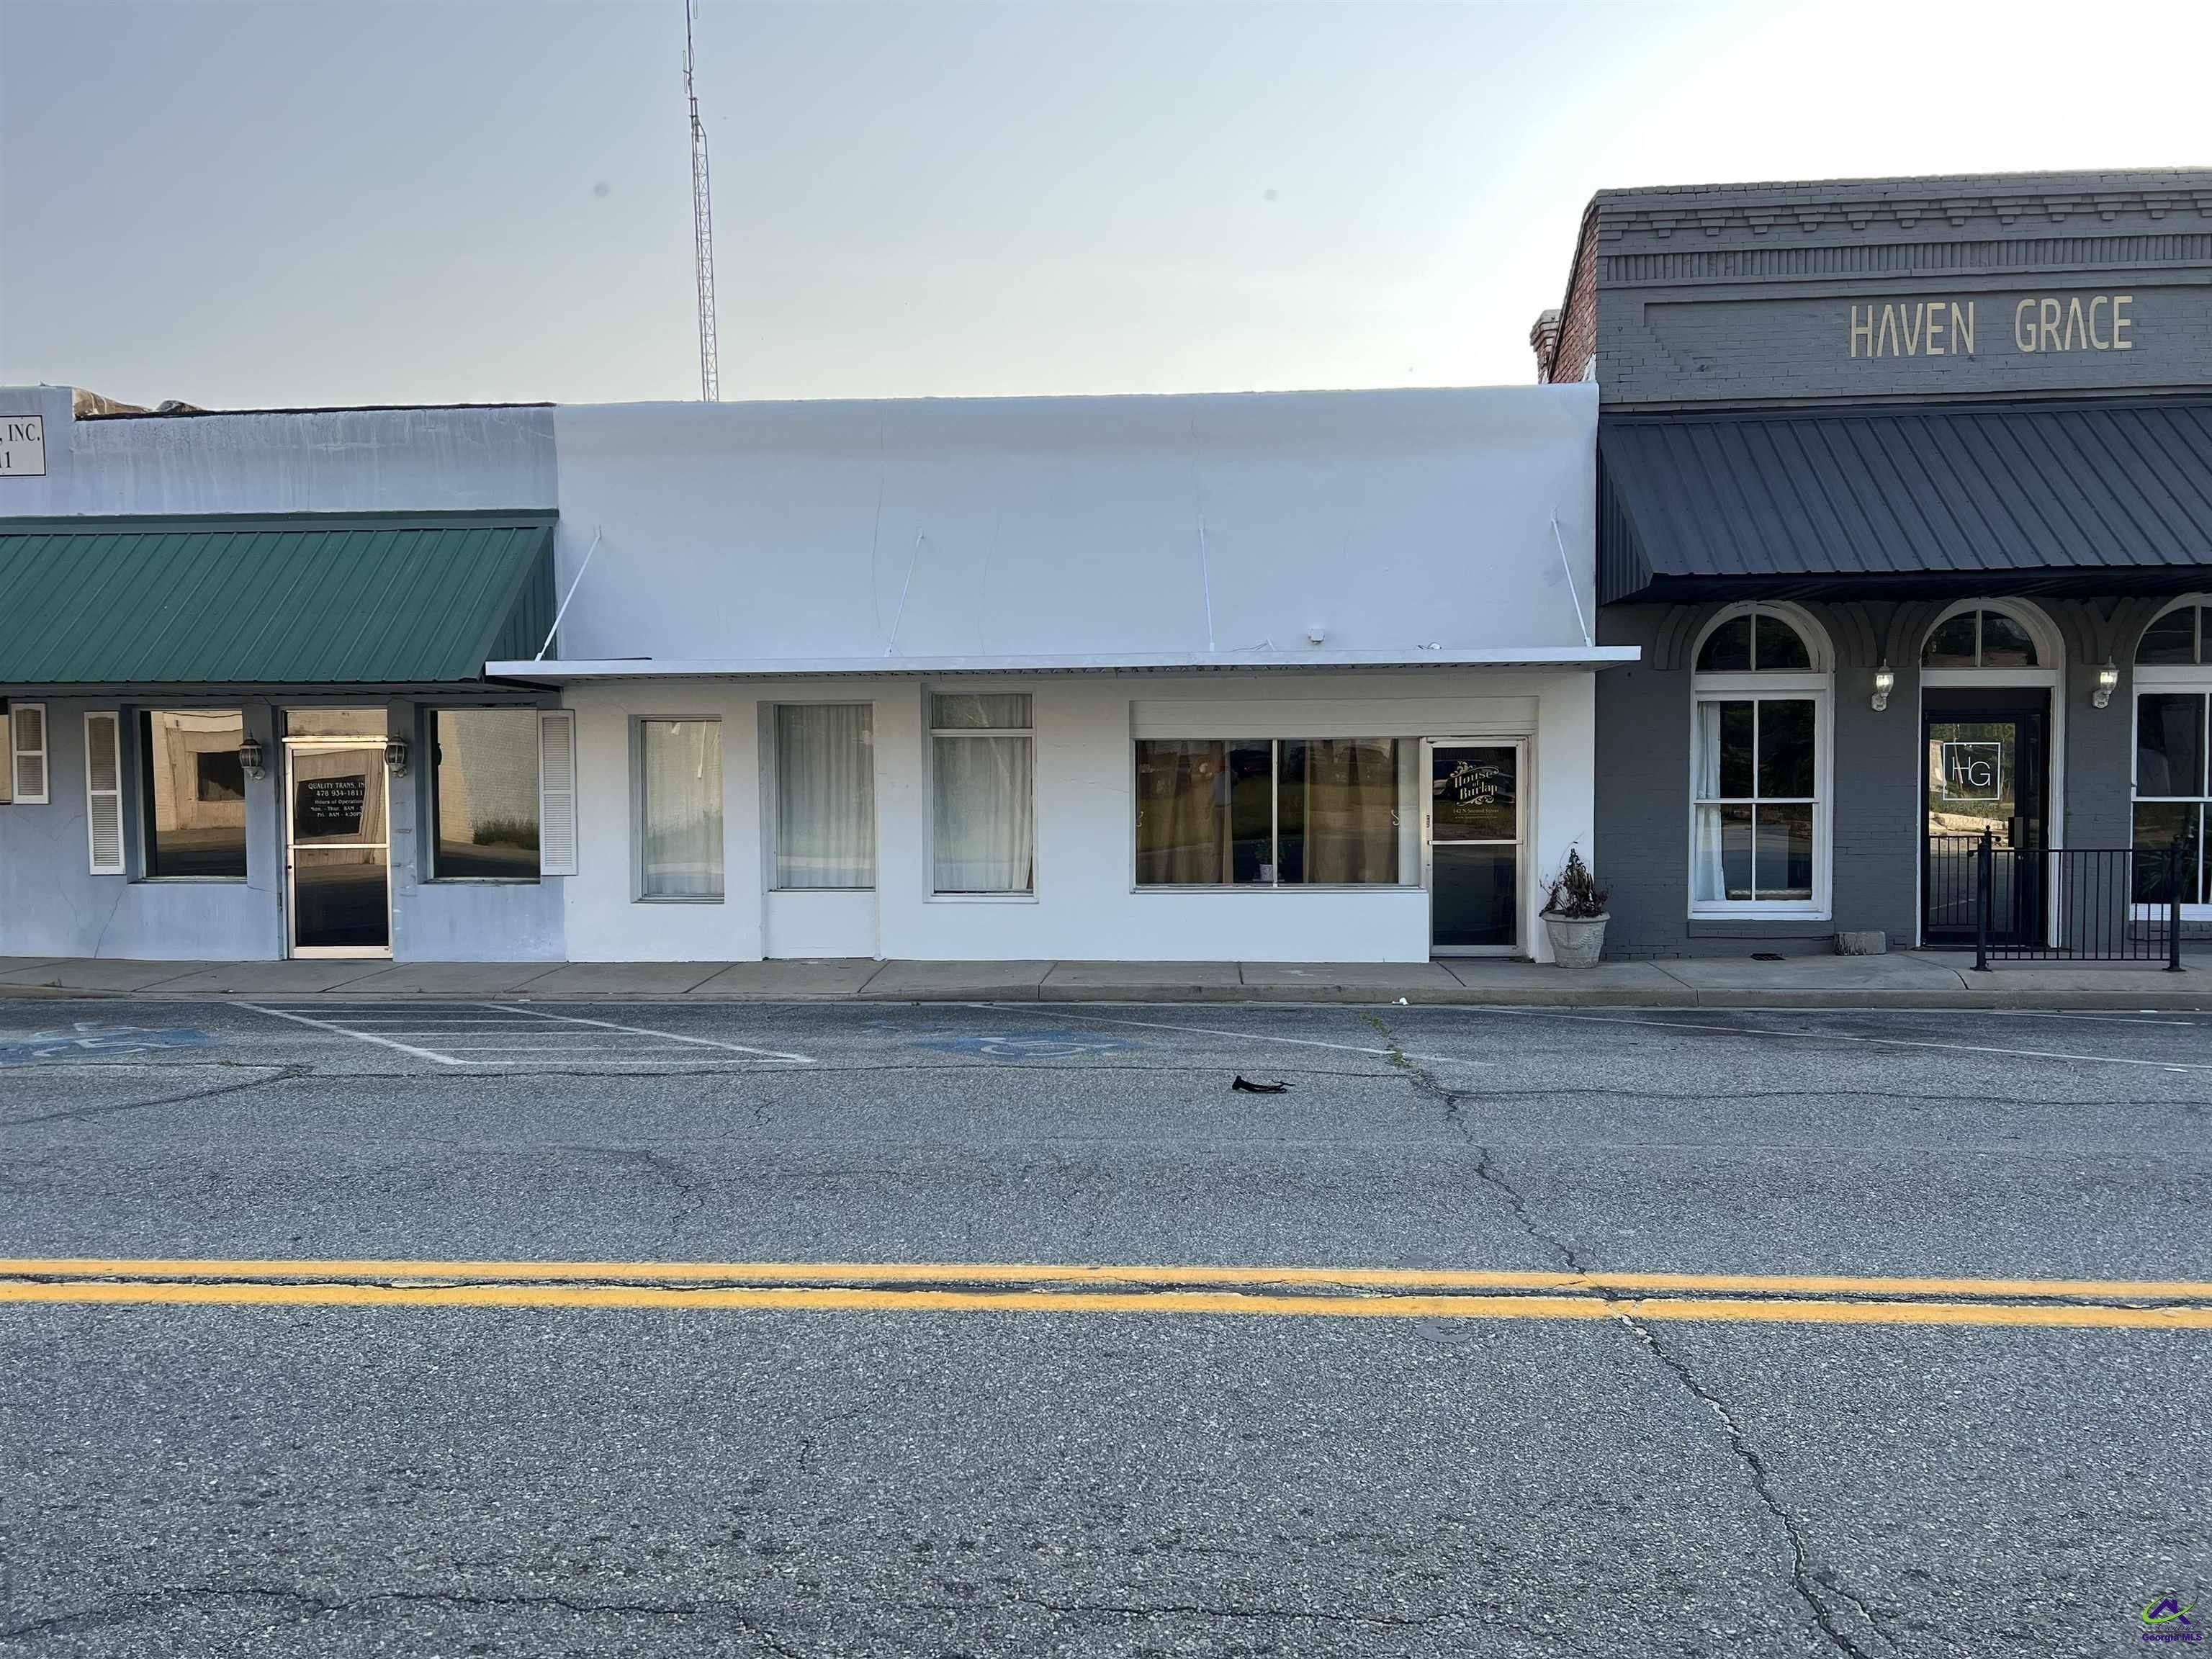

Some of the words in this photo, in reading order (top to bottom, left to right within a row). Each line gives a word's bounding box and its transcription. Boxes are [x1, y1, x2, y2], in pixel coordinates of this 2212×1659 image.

[1851, 301, 1974, 358] HAVEN
[2015, 295, 2134, 353] GRACE
[9, 423, 40, 441] INC.
[1455, 771, 1493, 788] House
[1460, 781, 1498, 799] Burlap
